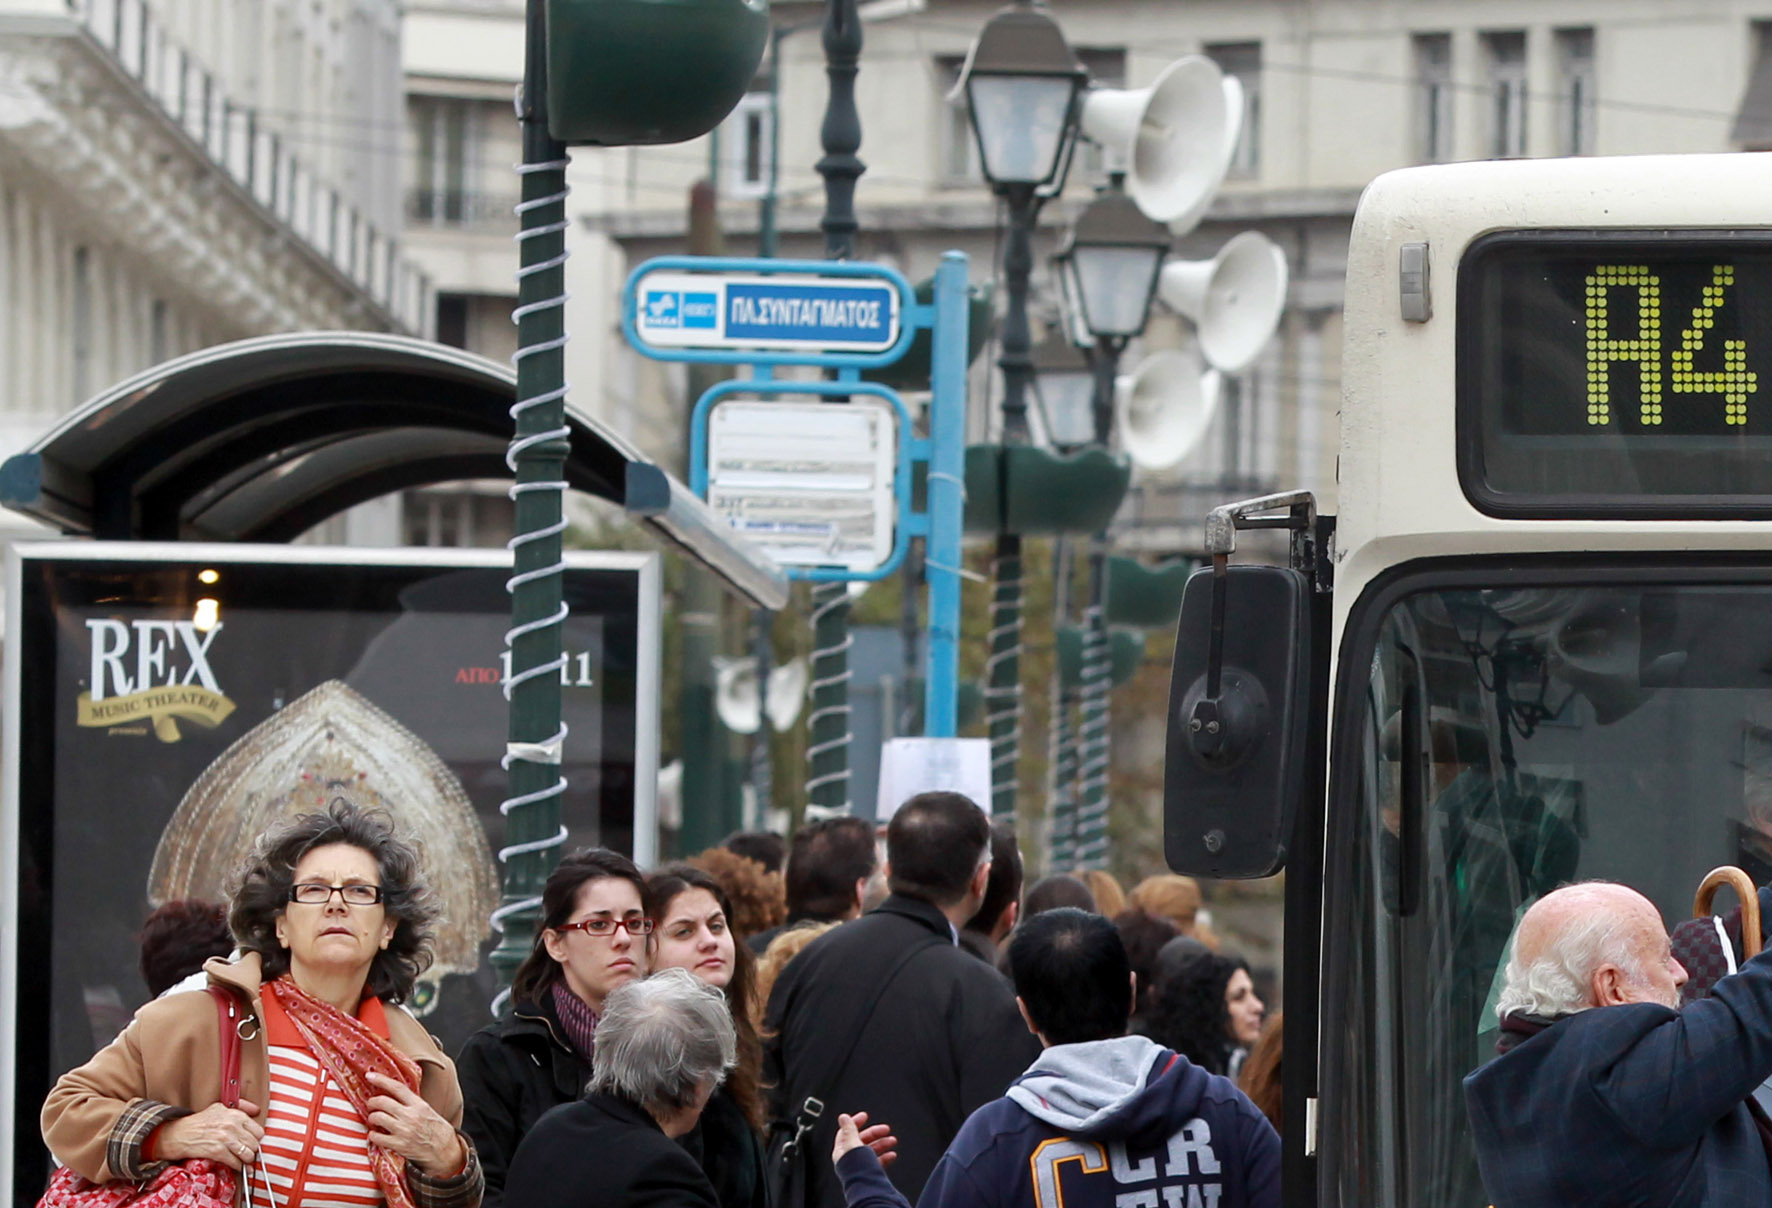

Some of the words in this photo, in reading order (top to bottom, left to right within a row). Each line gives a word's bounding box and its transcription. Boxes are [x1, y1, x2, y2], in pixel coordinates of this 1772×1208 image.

[85, 619, 224, 702] REX
[91, 701, 140, 719] MUSIC
[143, 692, 220, 711] THEATER
